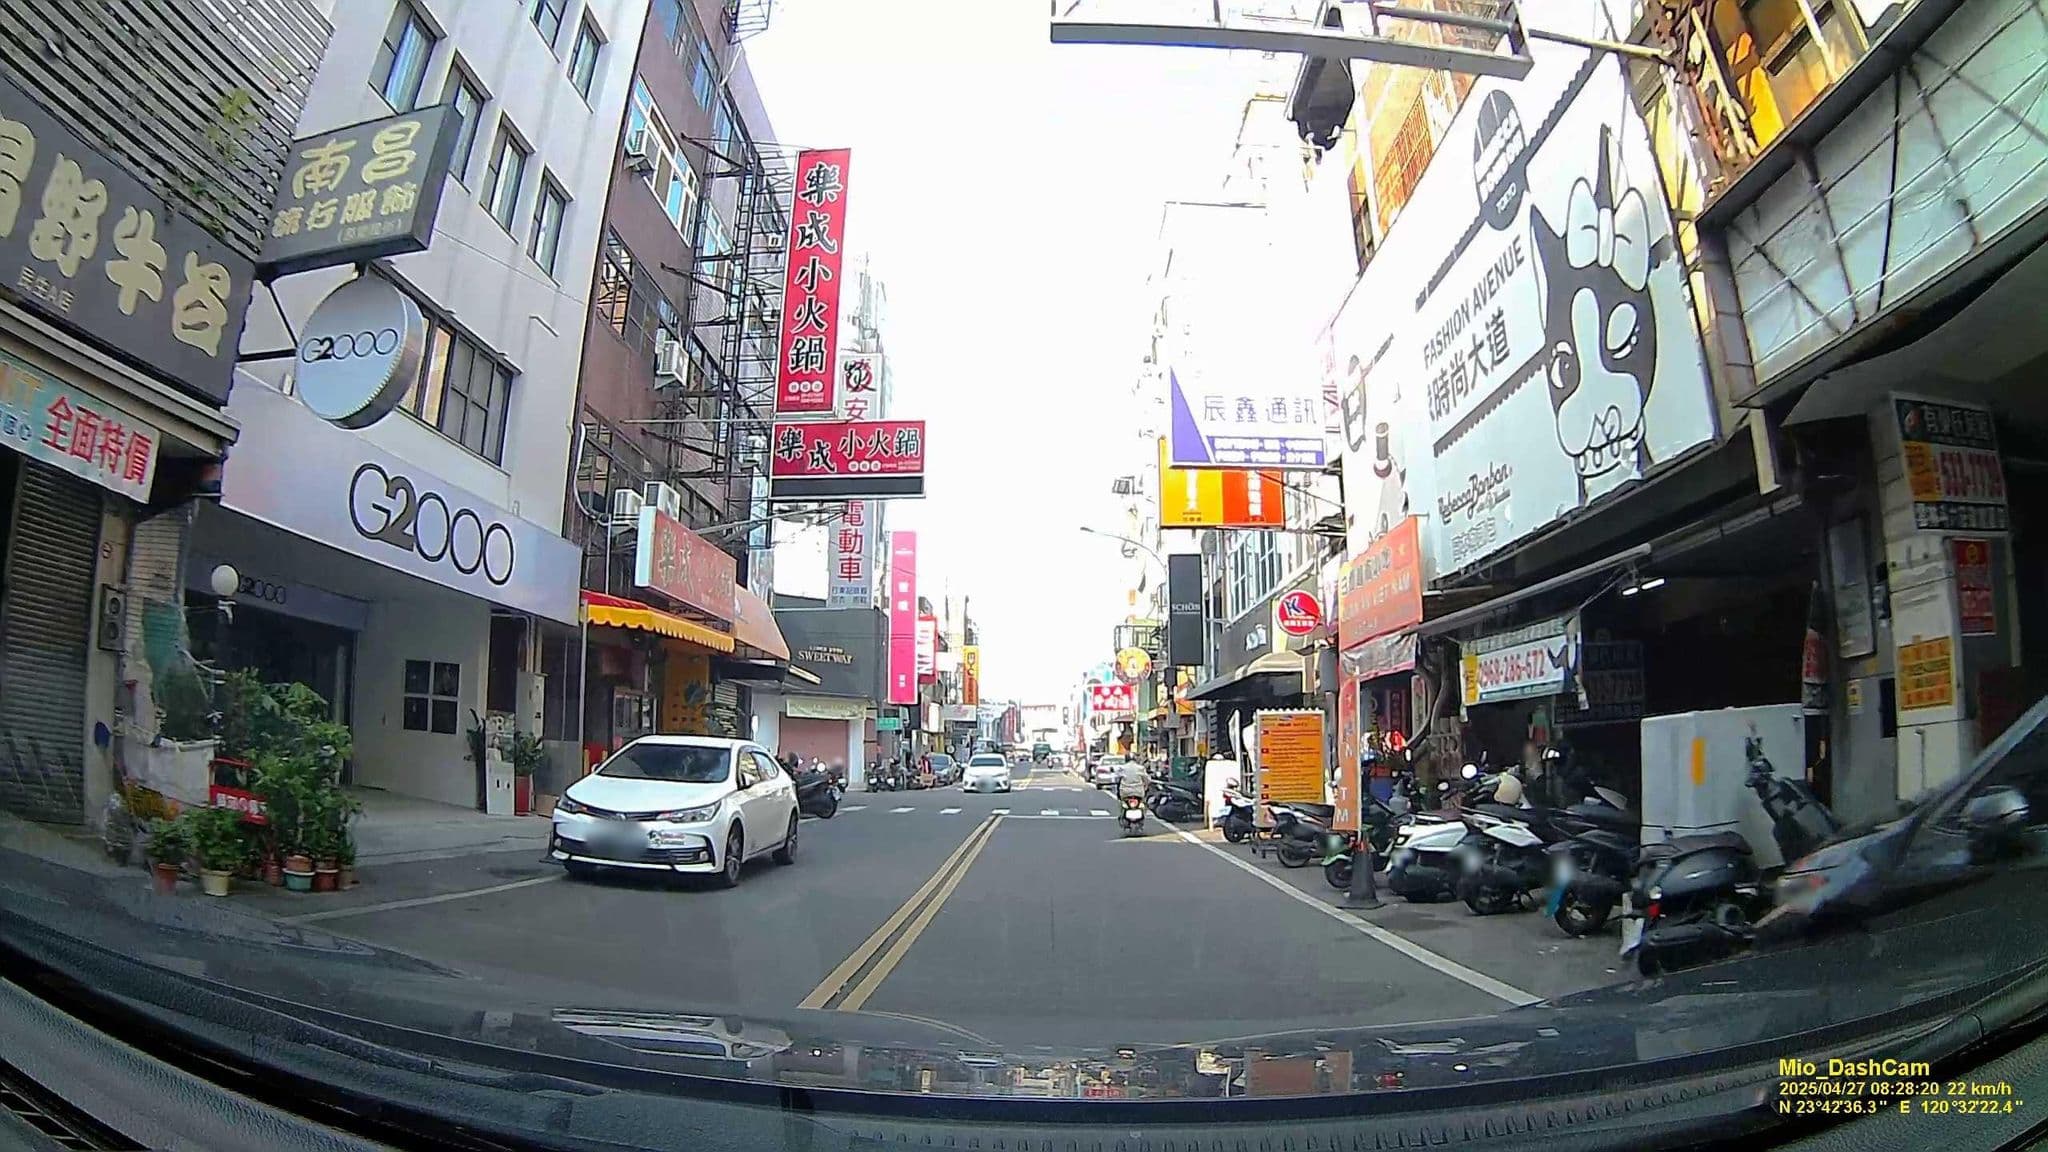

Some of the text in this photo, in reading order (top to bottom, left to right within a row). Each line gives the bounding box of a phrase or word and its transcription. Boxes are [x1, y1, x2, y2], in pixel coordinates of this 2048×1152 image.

[292, 120, 421, 200] 南昌
[788, 161, 843, 374] 樂成小火鍋
[1423, 297, 1471, 371] FASHION
[1473, 234, 1525, 317] AVENUE
[302, 328, 398, 363] G2000
[41, 396, 152, 485] 全面特價
[776, 427, 921, 473] 樂成小火鍋
[1204, 395, 1317, 424] 辰鑫通訊
[350, 463, 514, 586] G2000
[837, 500, 865, 582] 電動車
